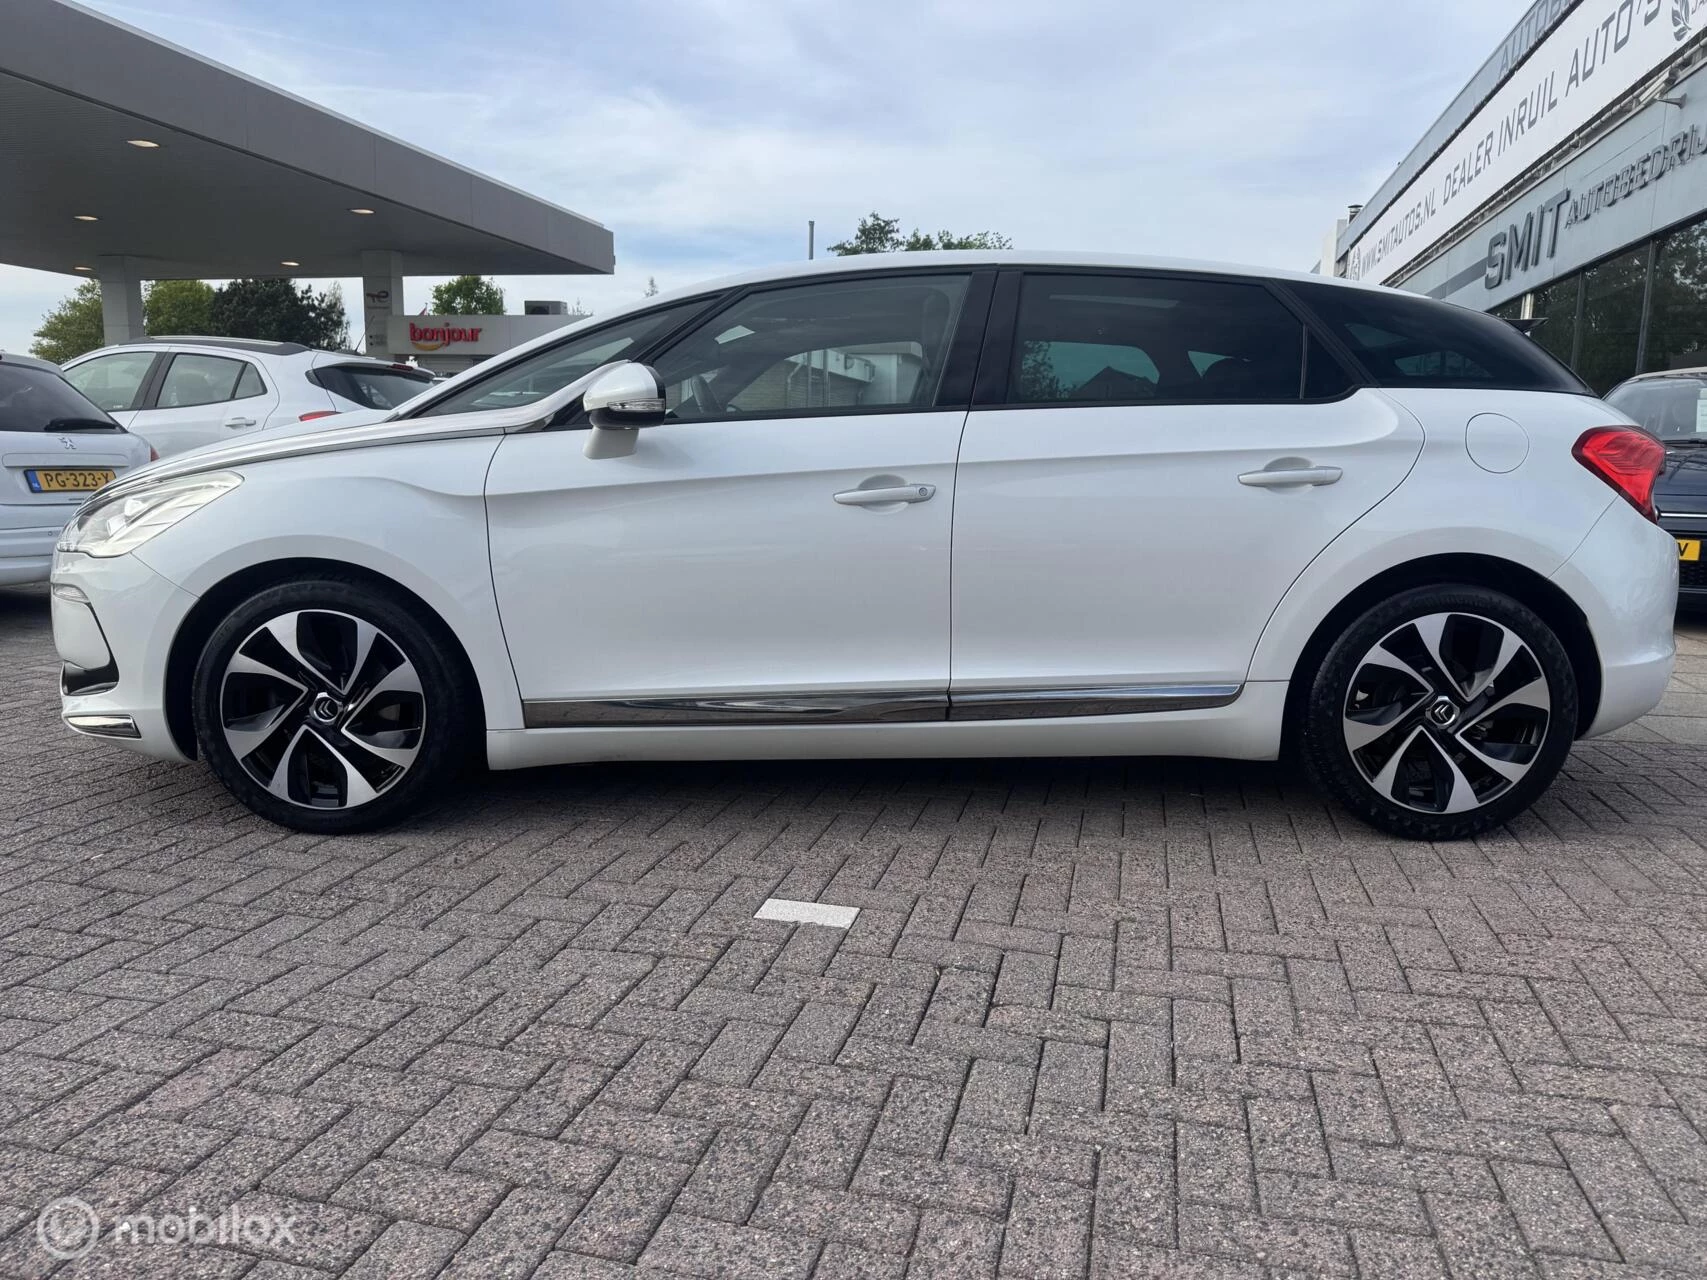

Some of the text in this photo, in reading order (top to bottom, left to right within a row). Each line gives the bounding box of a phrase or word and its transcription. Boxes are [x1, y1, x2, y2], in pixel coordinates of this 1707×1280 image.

[1443, 130, 1494, 206] DEALER
[1497, 70, 1558, 157] INRUIL
[1484, 187, 1571, 290] SMIT
[409, 322, 483, 348] bonjour
